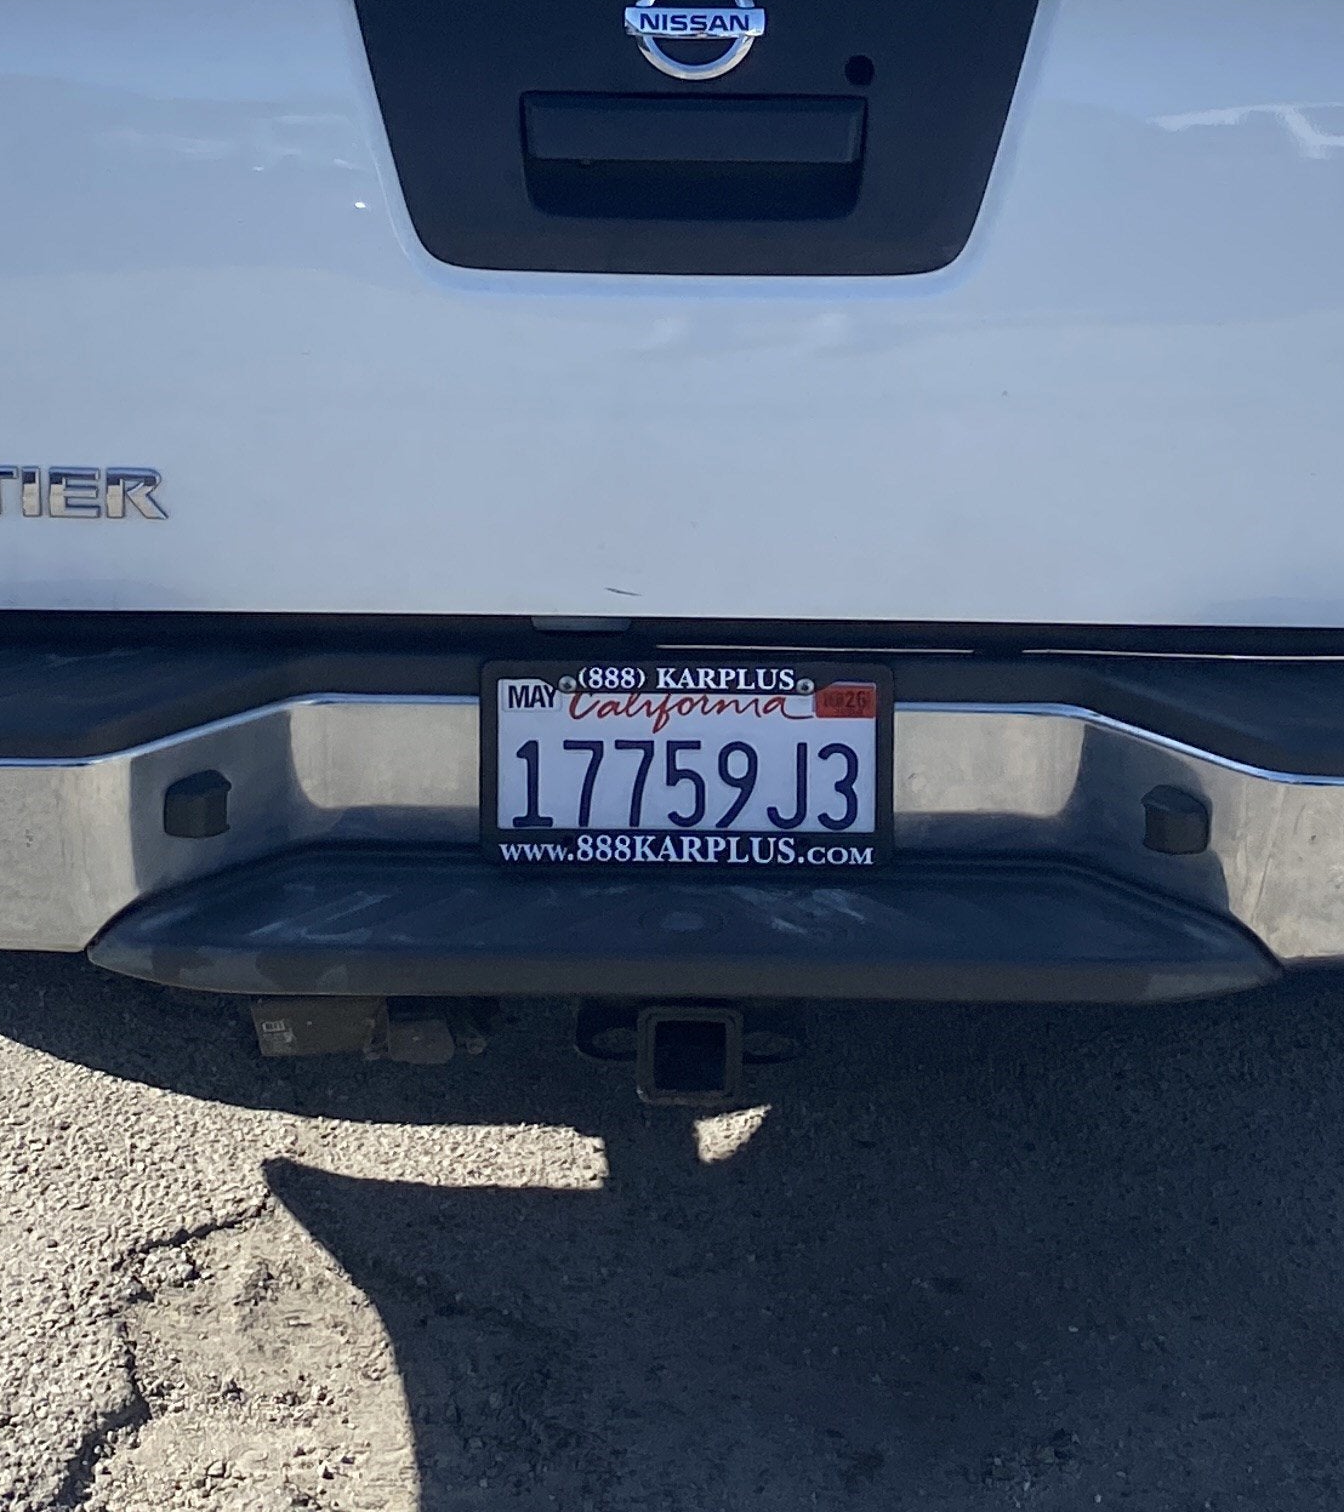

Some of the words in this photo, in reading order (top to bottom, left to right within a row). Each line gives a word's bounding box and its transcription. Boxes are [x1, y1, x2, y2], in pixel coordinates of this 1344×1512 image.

[640, 13, 750, 31] NISSAN
[578, 667, 646, 690] (888)
[656, 668, 795, 691] KARPLUS
[508, 685, 556, 709] MAY
[568, 691, 815, 734] California
[512, 740, 859, 830] 17759J3
